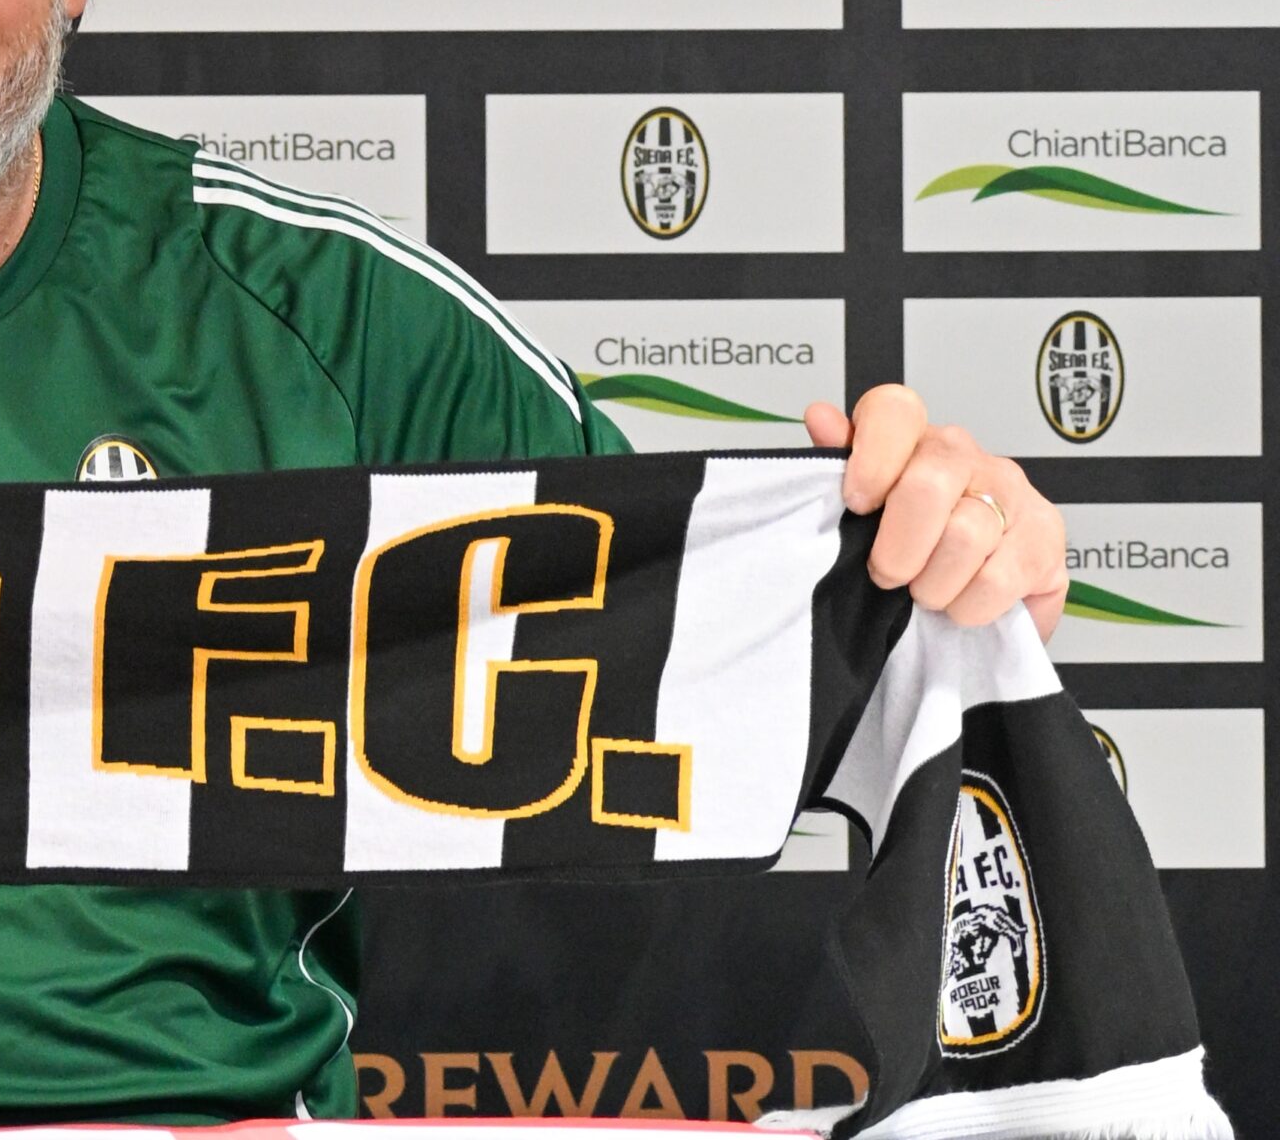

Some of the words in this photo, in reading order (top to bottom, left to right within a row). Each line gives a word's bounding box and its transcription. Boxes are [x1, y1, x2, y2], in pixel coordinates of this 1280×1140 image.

[178, 133, 395, 161] hiantiBanca
[1007, 129, 1227, 158] ChiantiBanca
[594, 337, 814, 366] ChiantiBanca
[1065, 541, 1229, 570] antiBanca
[92, 503, 692, 833] F.C.
[973, 844, 1020, 891] F.C.
[355, 1047, 871, 1123] REWARD
